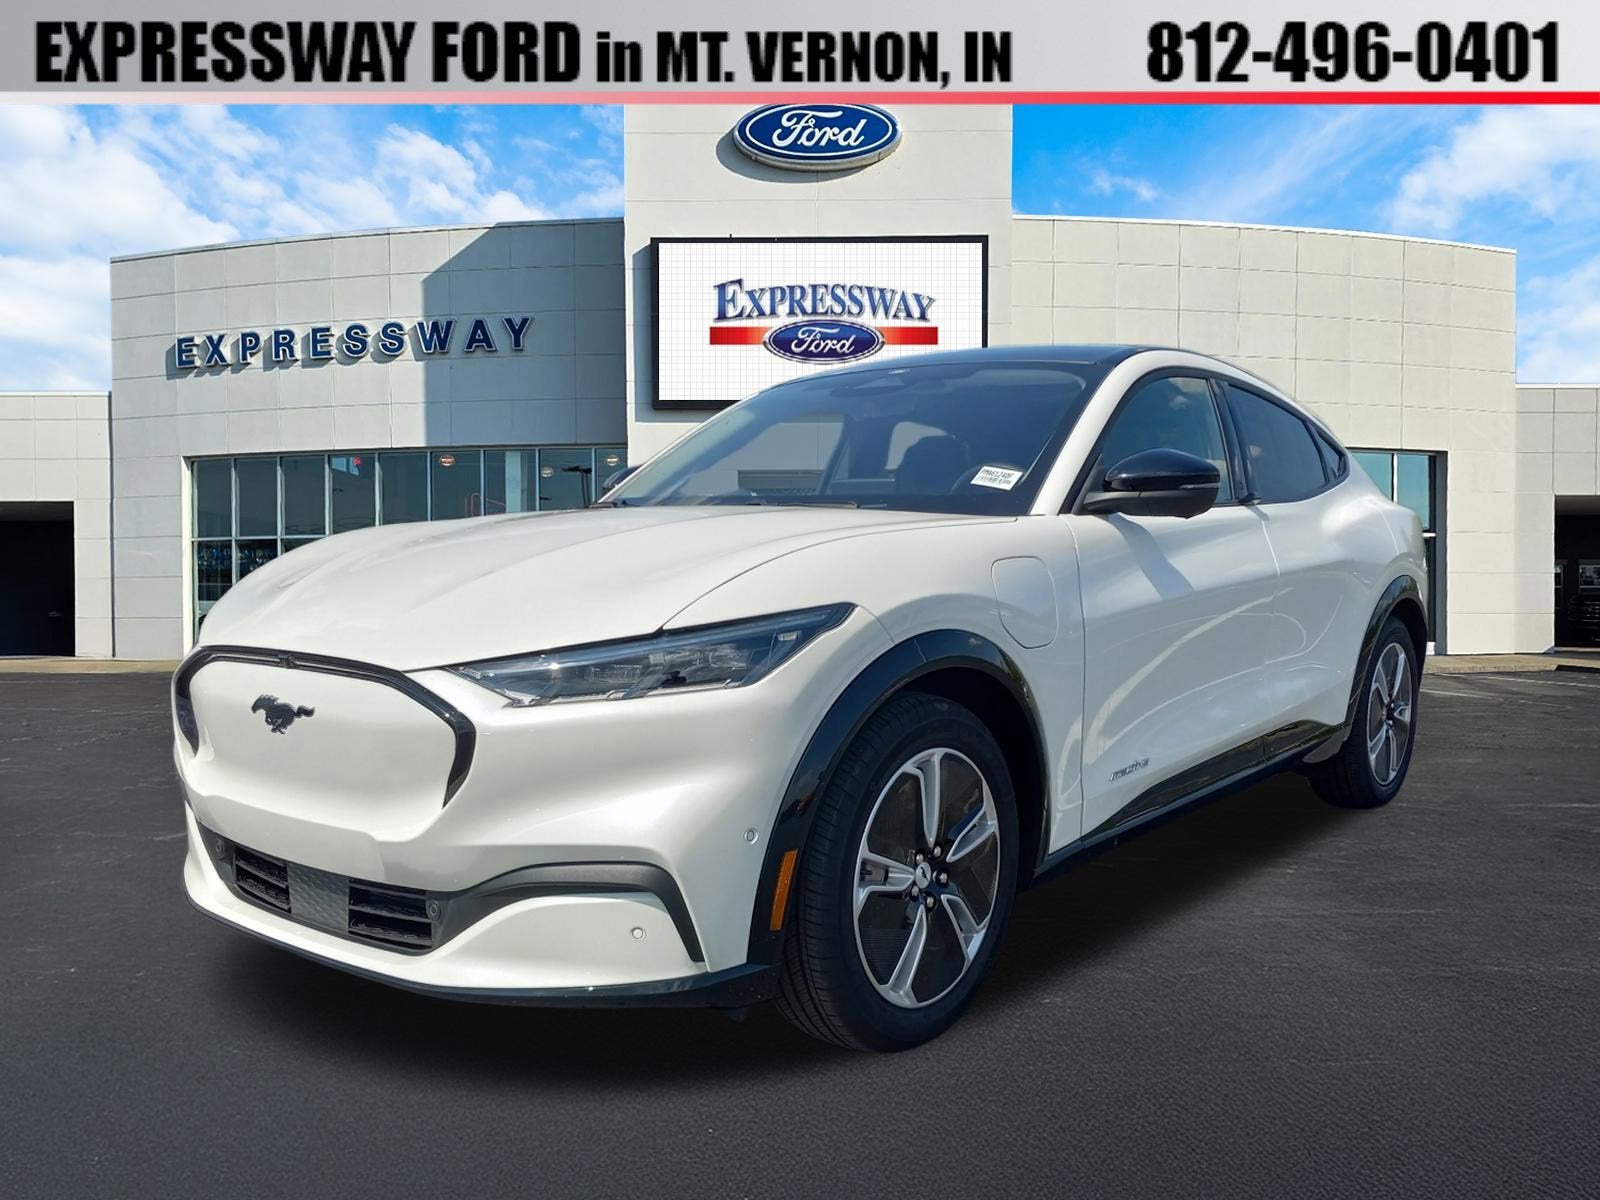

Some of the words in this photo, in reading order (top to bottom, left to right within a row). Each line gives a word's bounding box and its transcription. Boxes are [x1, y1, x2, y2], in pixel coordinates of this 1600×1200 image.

[771, 109, 865, 147] Ford
[712, 277, 936, 322] EXPRESSWAY
[175, 315, 533, 369] EXPRESSWAY
[790, 326, 856, 355] Ford
